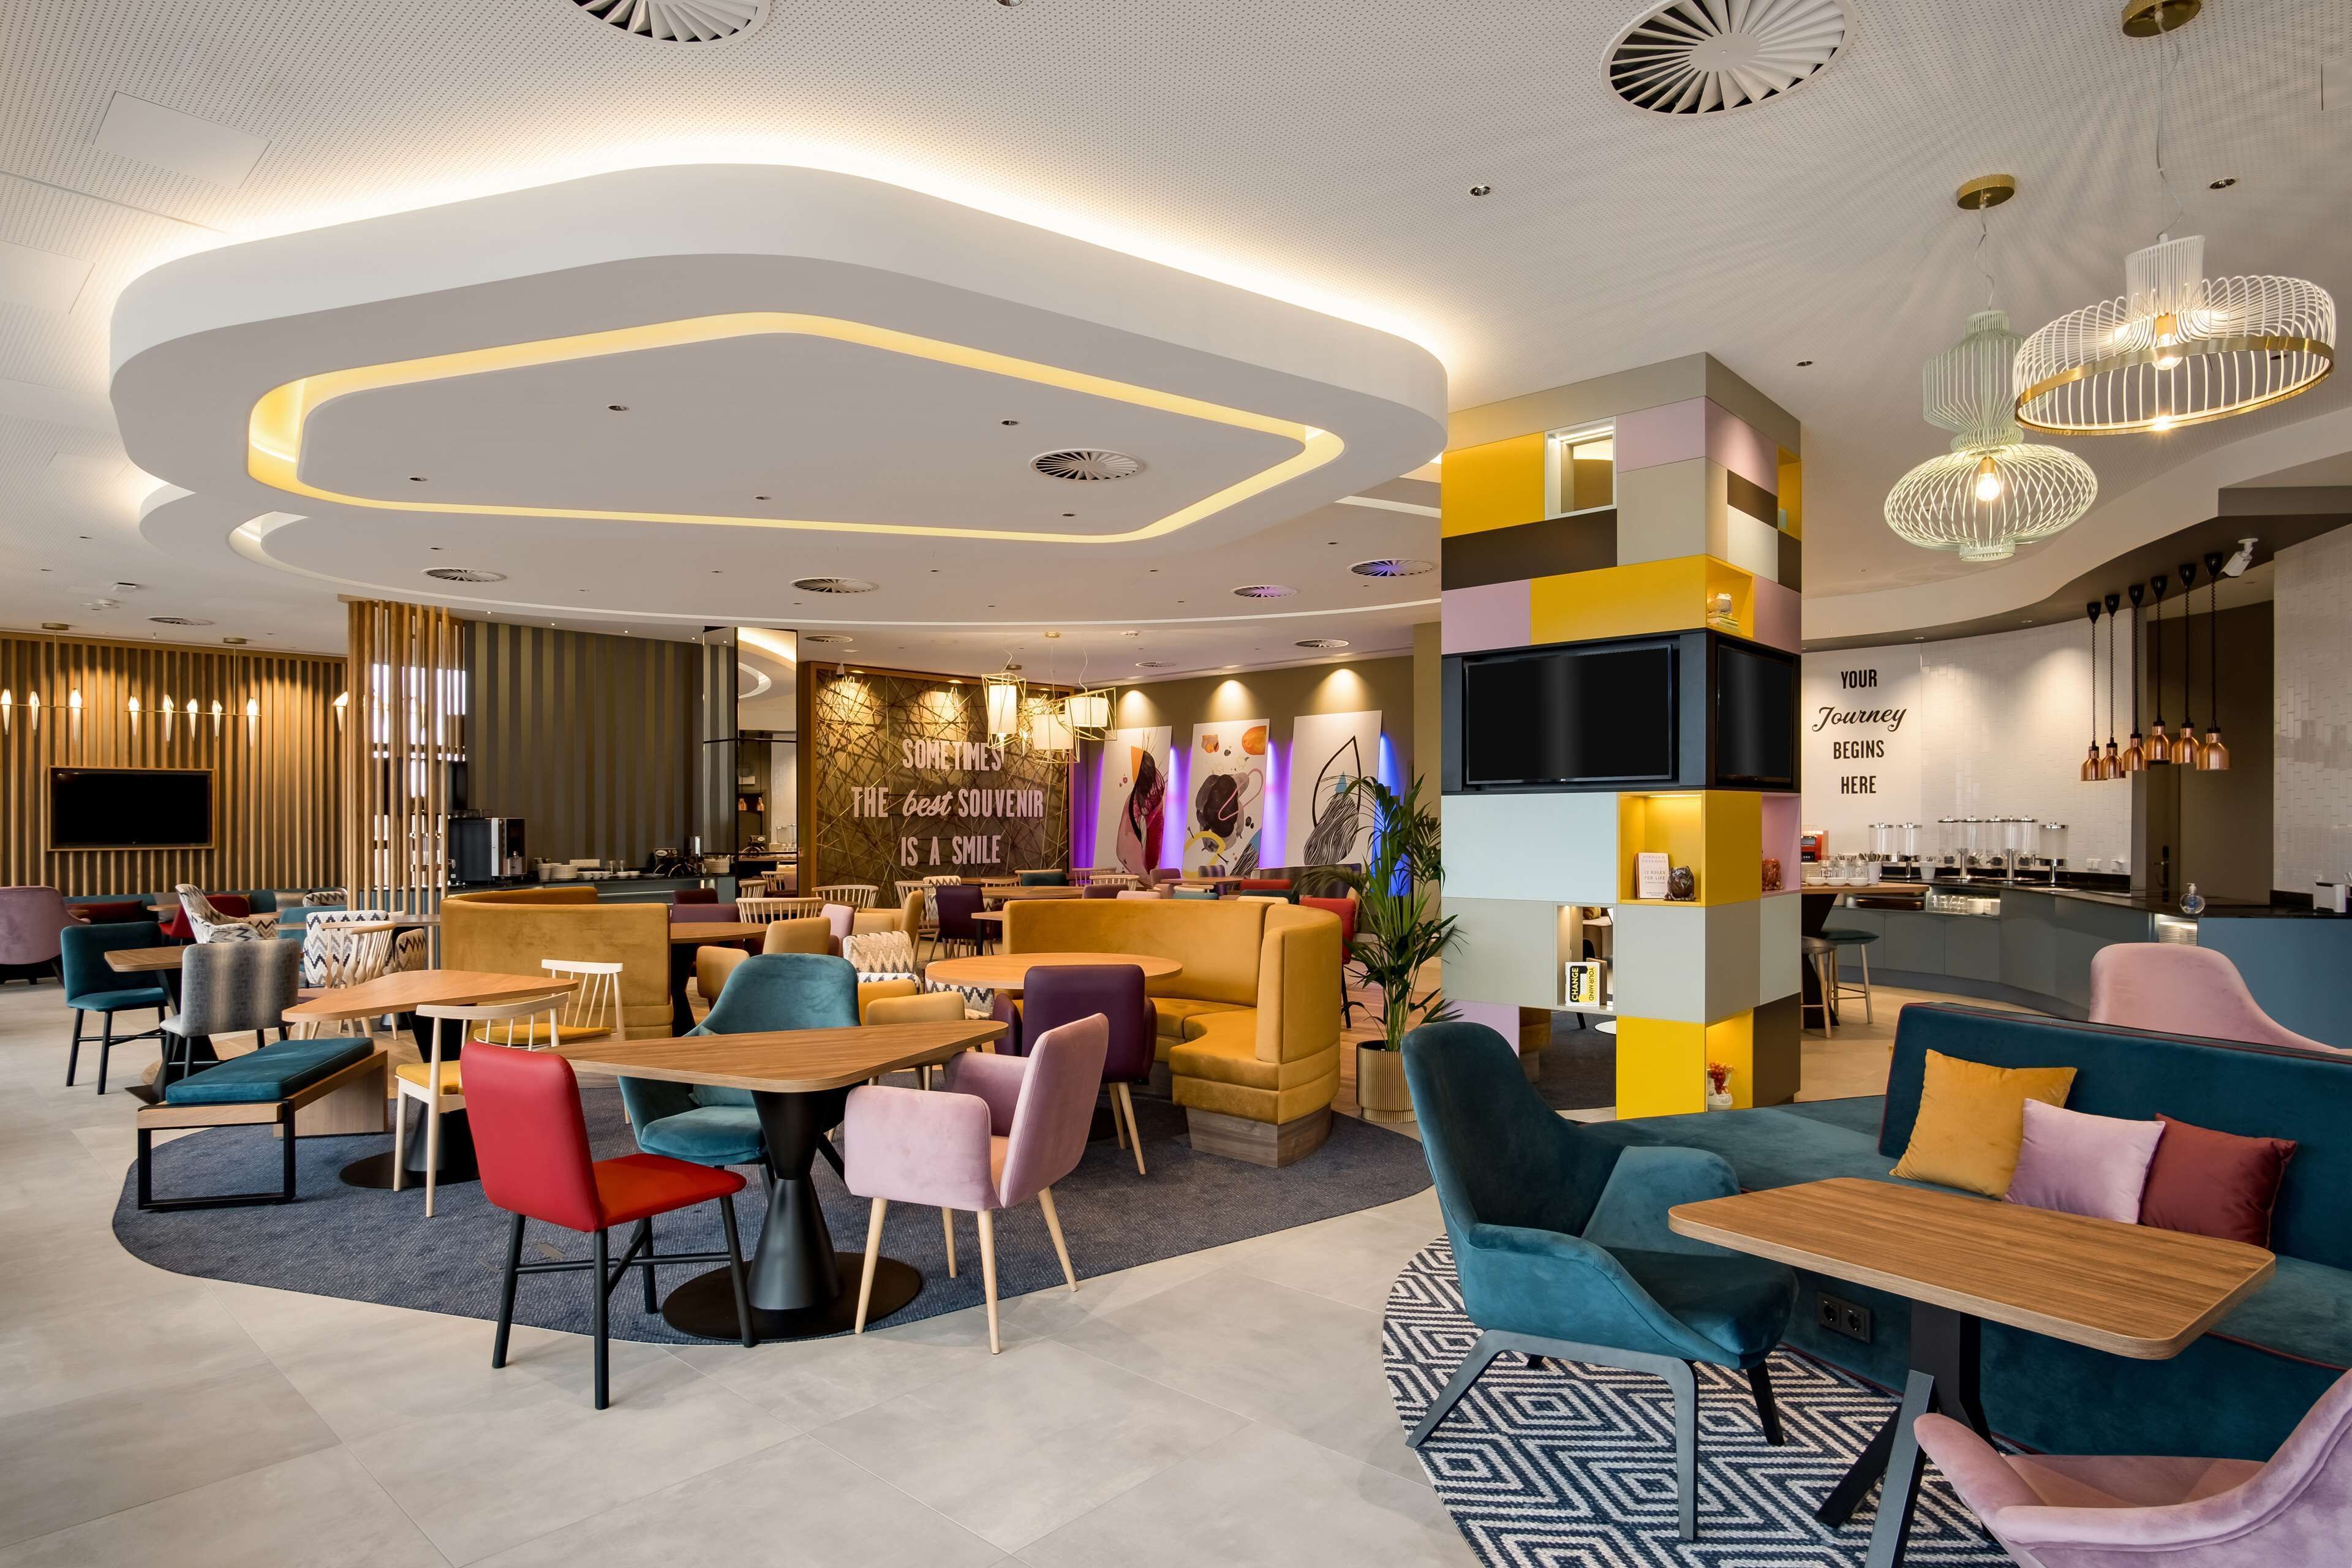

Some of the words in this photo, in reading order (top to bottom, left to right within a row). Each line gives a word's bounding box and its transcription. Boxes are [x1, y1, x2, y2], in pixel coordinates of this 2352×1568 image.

[1841, 669, 1877, 689] YOUR
[1812, 706, 1907, 732] Journey
[902, 739, 1002, 771] SOMETIMES
[1833, 740, 1885, 760] BEGINS
[1841, 775, 1877, 794] HERE
[851, 786, 888, 818] THE
[902, 790, 953, 818] best
[958, 788, 1043, 817] SOUVENIR
[900, 837, 918, 866] IS
[929, 836, 941, 865] A
[952, 835, 1001, 865] SMILE
